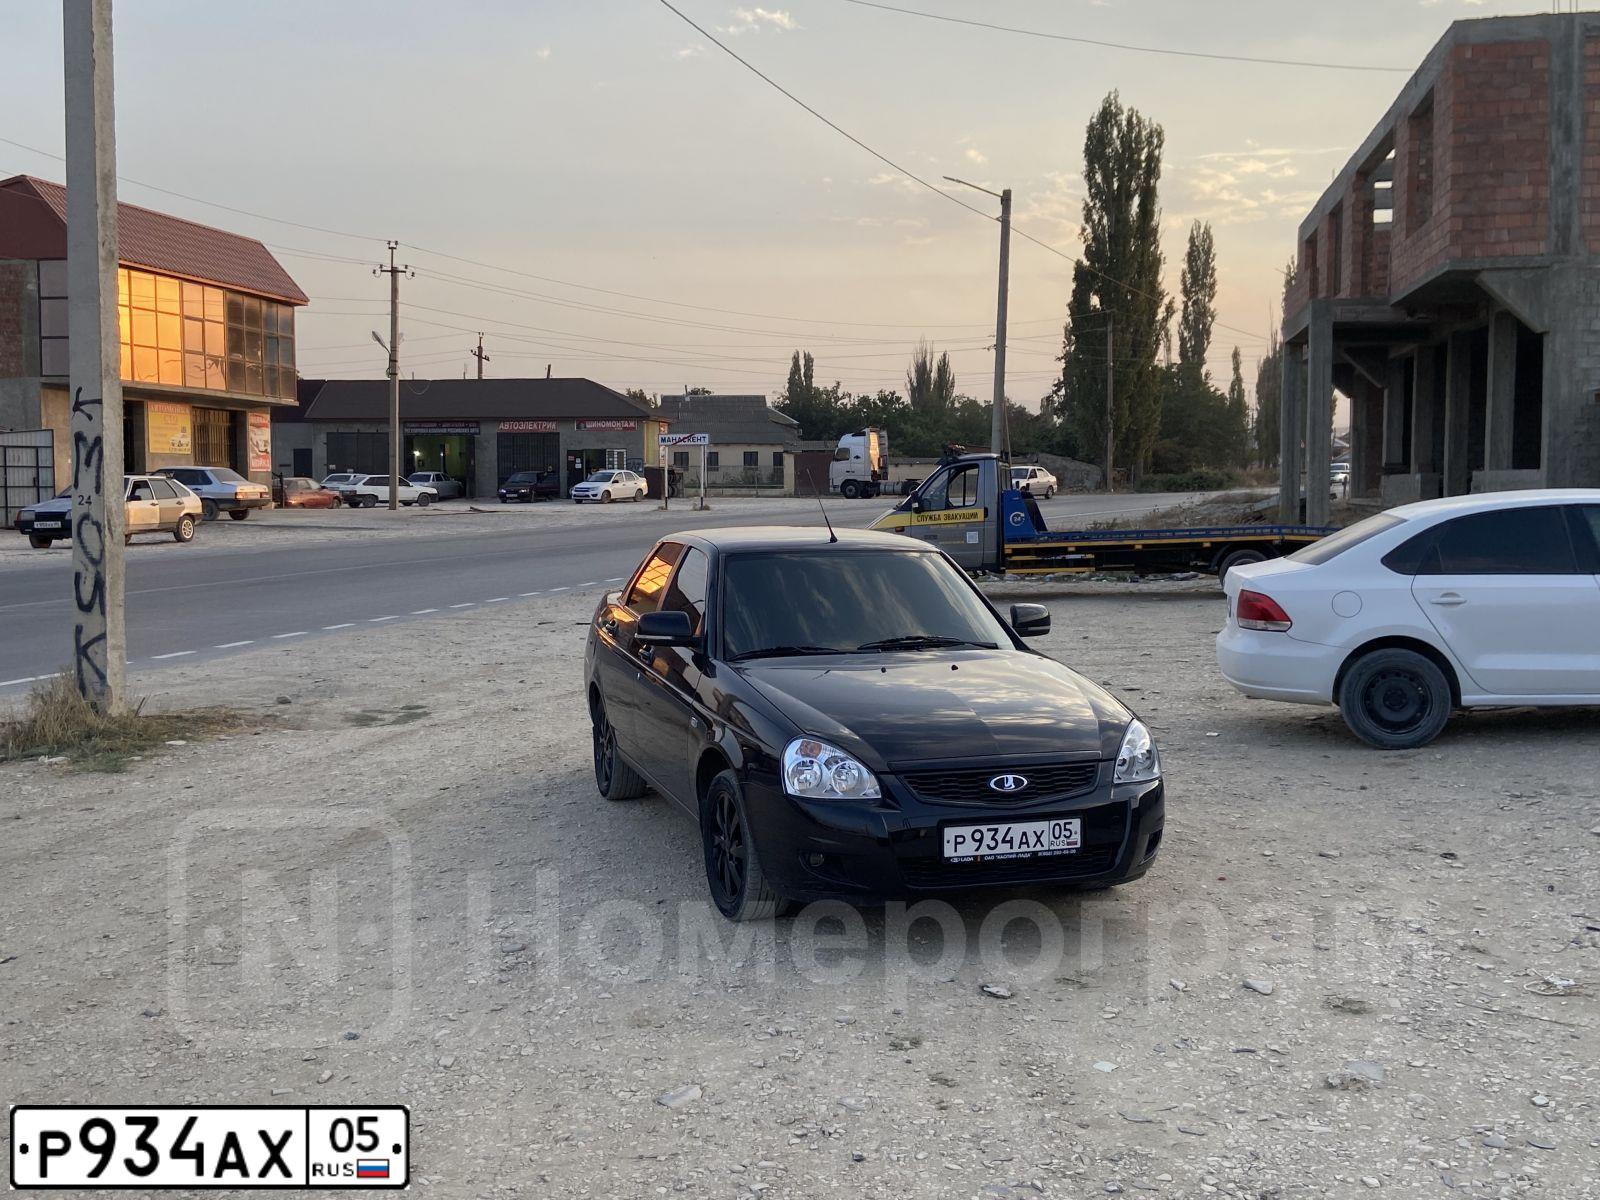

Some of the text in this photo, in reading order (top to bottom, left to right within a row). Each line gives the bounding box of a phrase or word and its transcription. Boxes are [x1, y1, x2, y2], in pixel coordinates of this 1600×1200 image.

[499, 421, 557, 431] АВТОЭЛЕКТРИК
[585, 419, 636, 428] ШИНОМОНТАЖ
[660, 436, 707, 444] МАНАСКЕНТ
[78, 494, 93, 506] 24
[916, 511, 979, 523] СЛУЖБА ЭВАКУАЦИИ
[1052, 821, 1073, 840] 05
[1050, 839, 1066, 847] RUS
